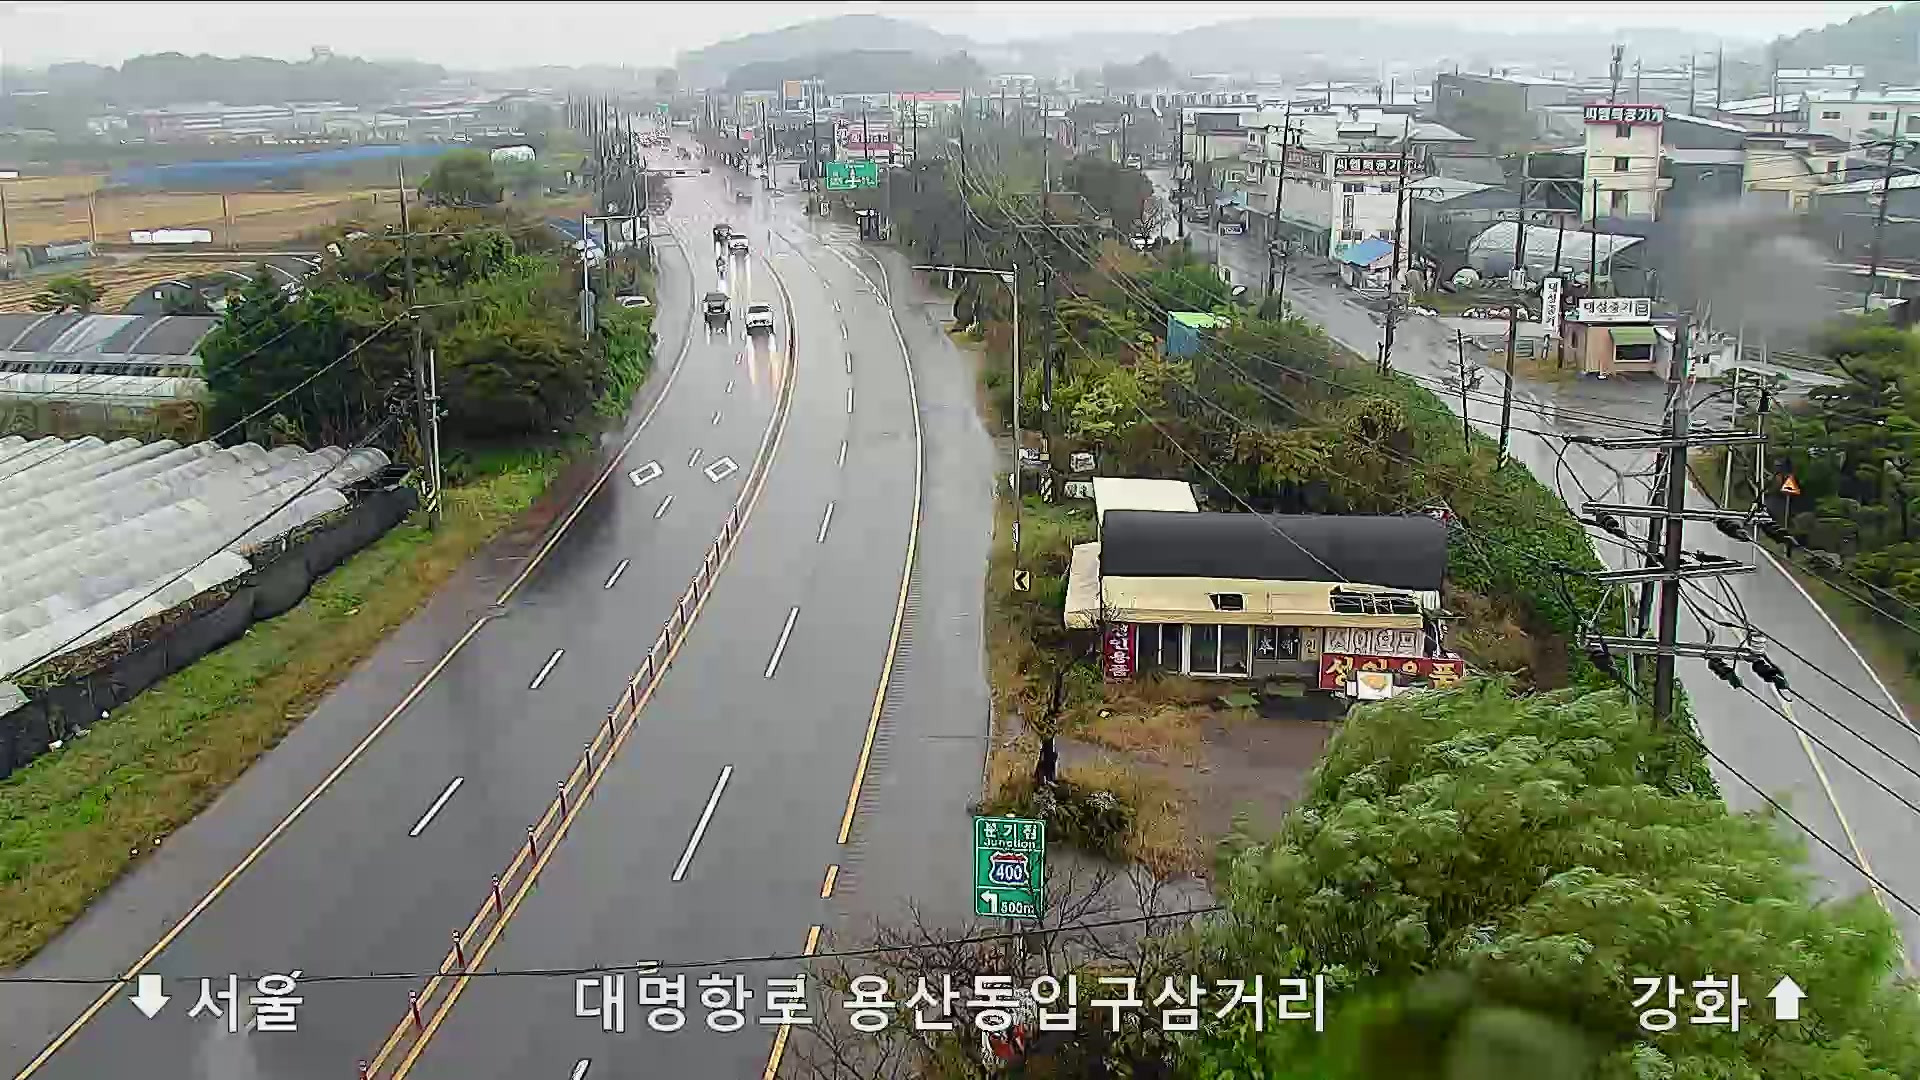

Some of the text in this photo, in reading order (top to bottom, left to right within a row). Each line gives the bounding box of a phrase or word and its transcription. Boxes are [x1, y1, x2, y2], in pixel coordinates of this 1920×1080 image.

[984, 822, 1037, 839] 분기점
[984, 839, 1036, 849] Junction
[995, 863, 1025, 881] 400
[1000, 902, 1036, 914] 500m
